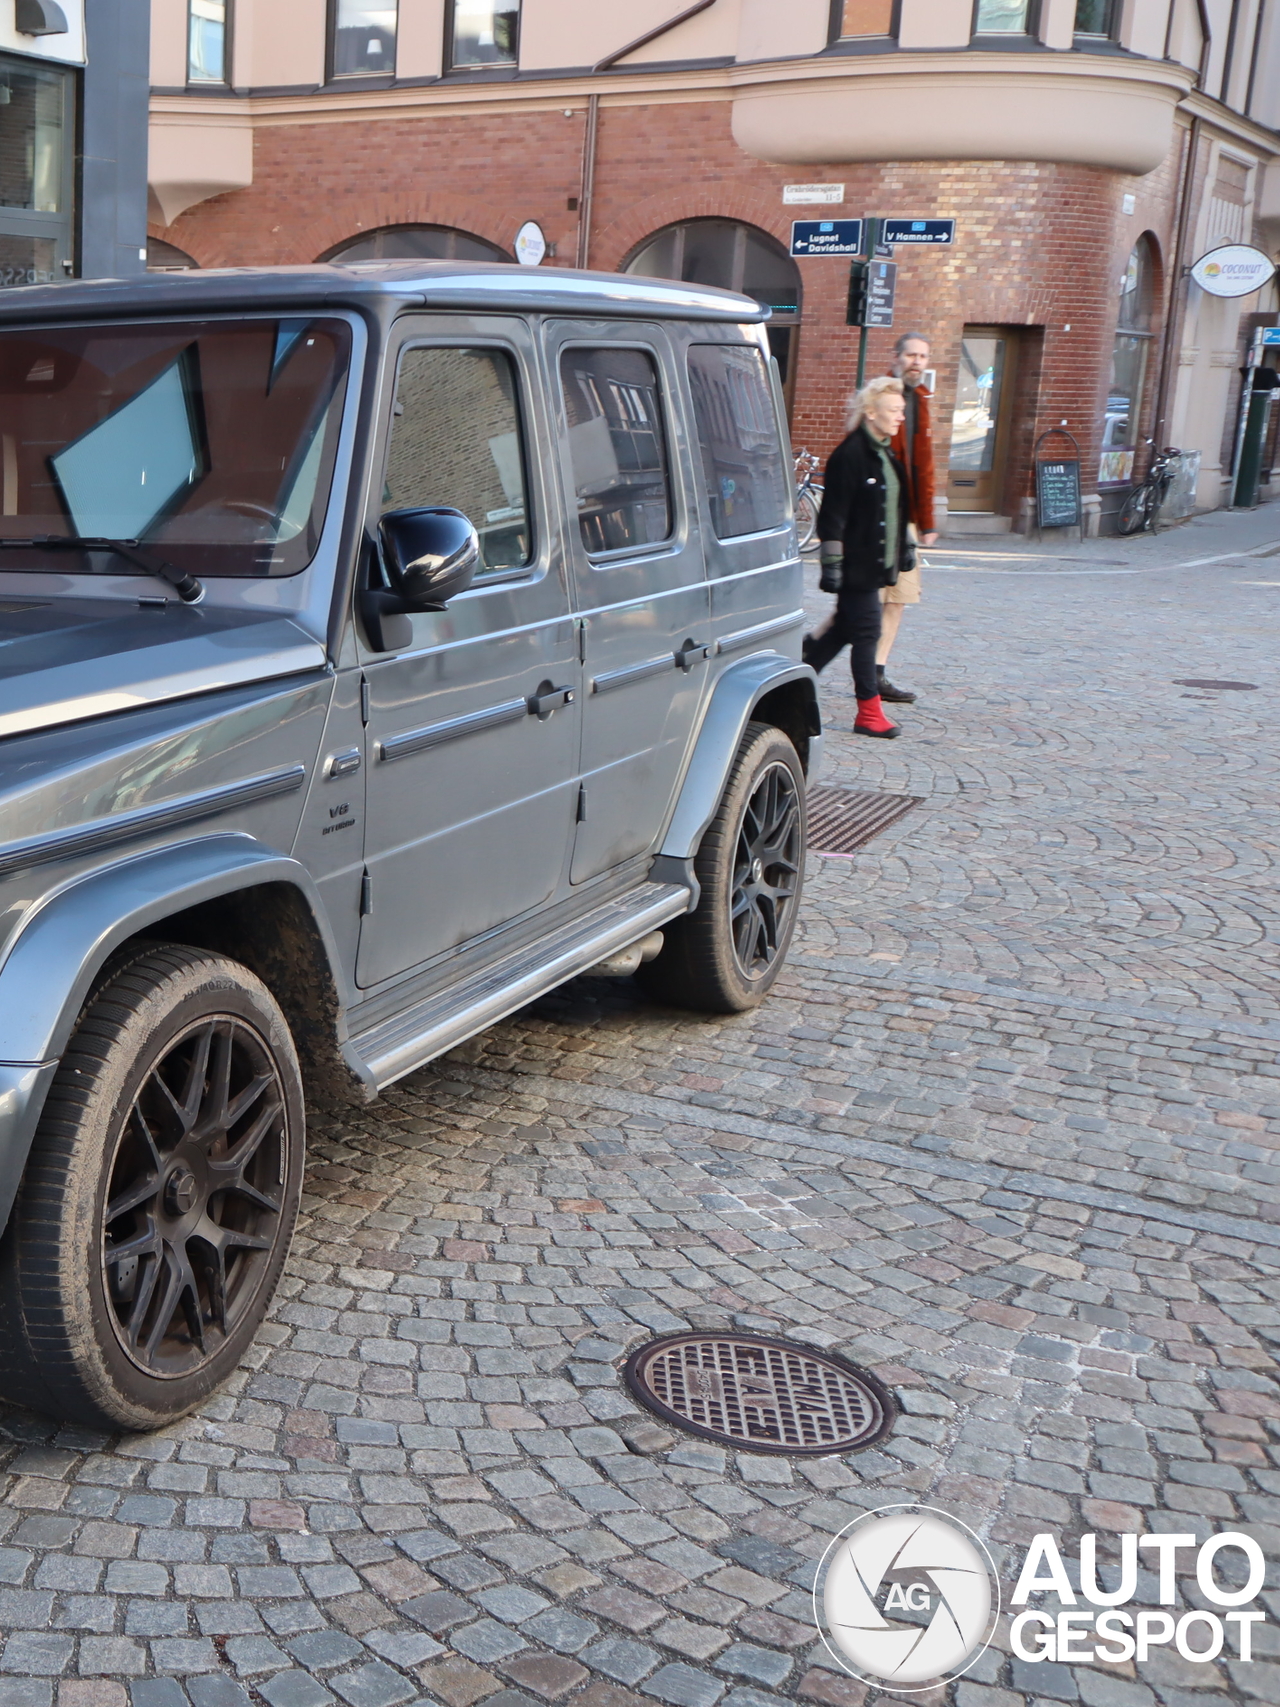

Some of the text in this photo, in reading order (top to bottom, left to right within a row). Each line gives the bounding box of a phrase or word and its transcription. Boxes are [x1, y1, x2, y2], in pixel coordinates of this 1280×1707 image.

[809, 234, 839, 244] Lugnet
[887, 232, 933, 240] V Hamnen
[808, 243, 856, 252] Davidshall
[1221, 264, 1263, 274] COCONUT
